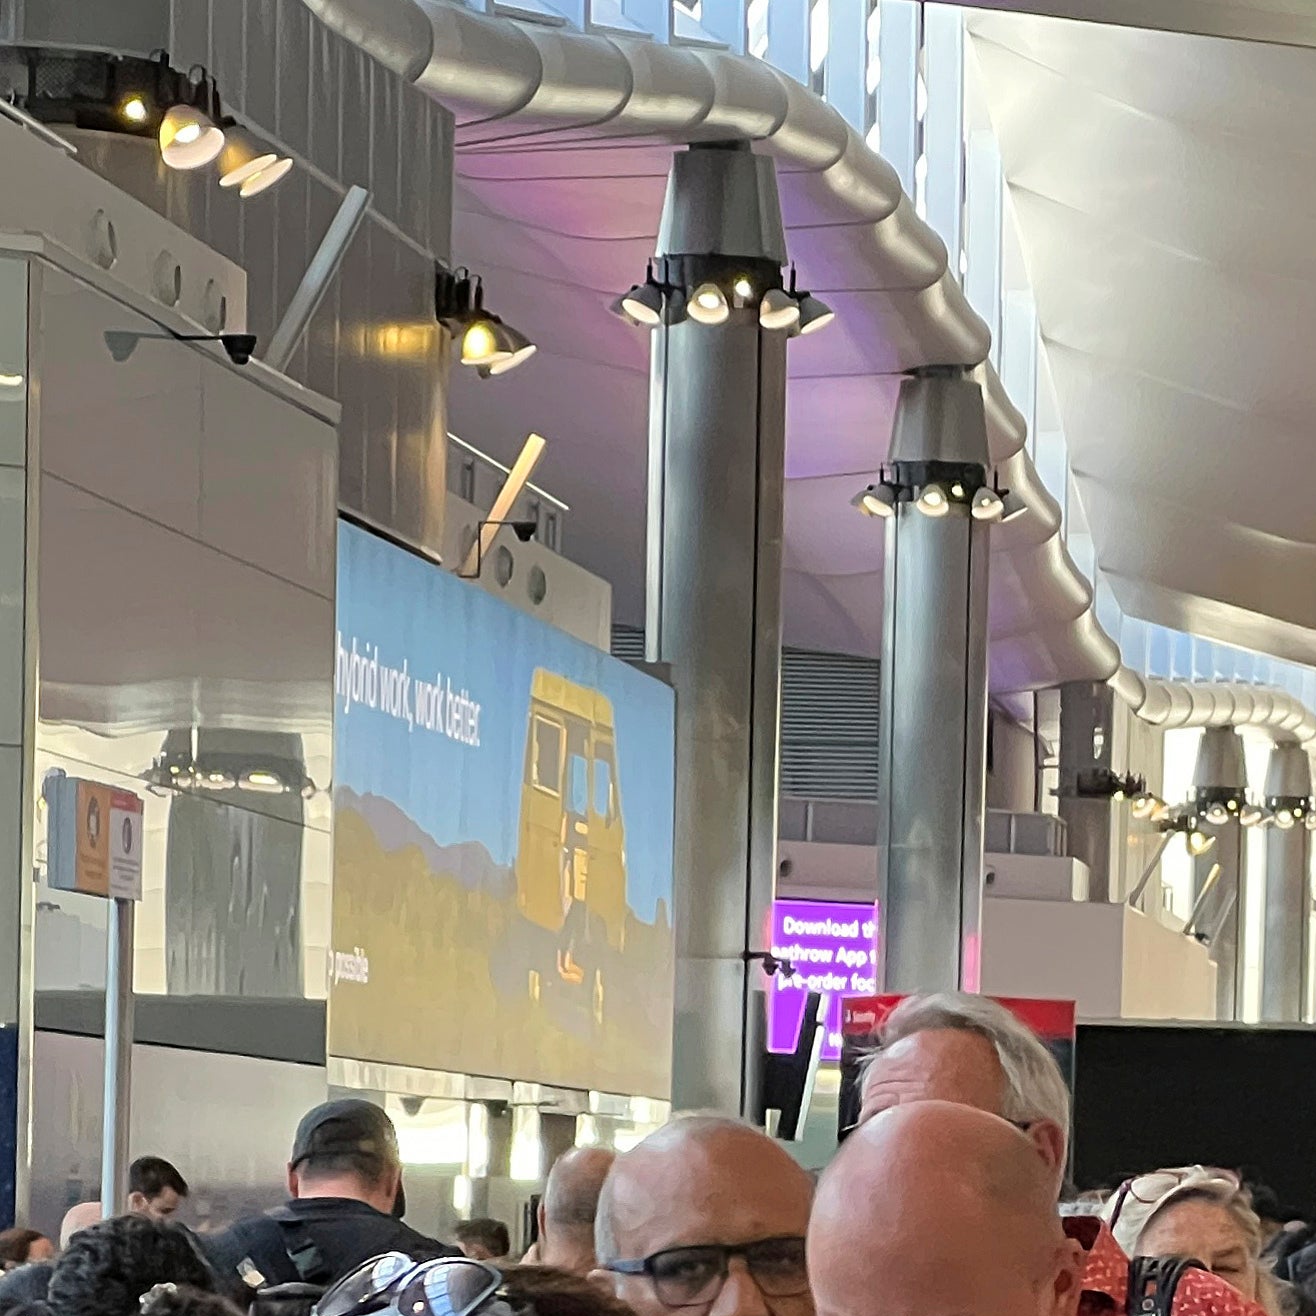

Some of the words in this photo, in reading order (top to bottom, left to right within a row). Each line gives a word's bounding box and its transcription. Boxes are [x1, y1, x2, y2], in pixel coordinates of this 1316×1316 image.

[335, 630, 378, 714] hybrid
[415, 672, 445, 733] work
[783, 916, 859, 938] Download
[770, 944, 833, 963] eathrow
[835, 946, 868, 968] App
